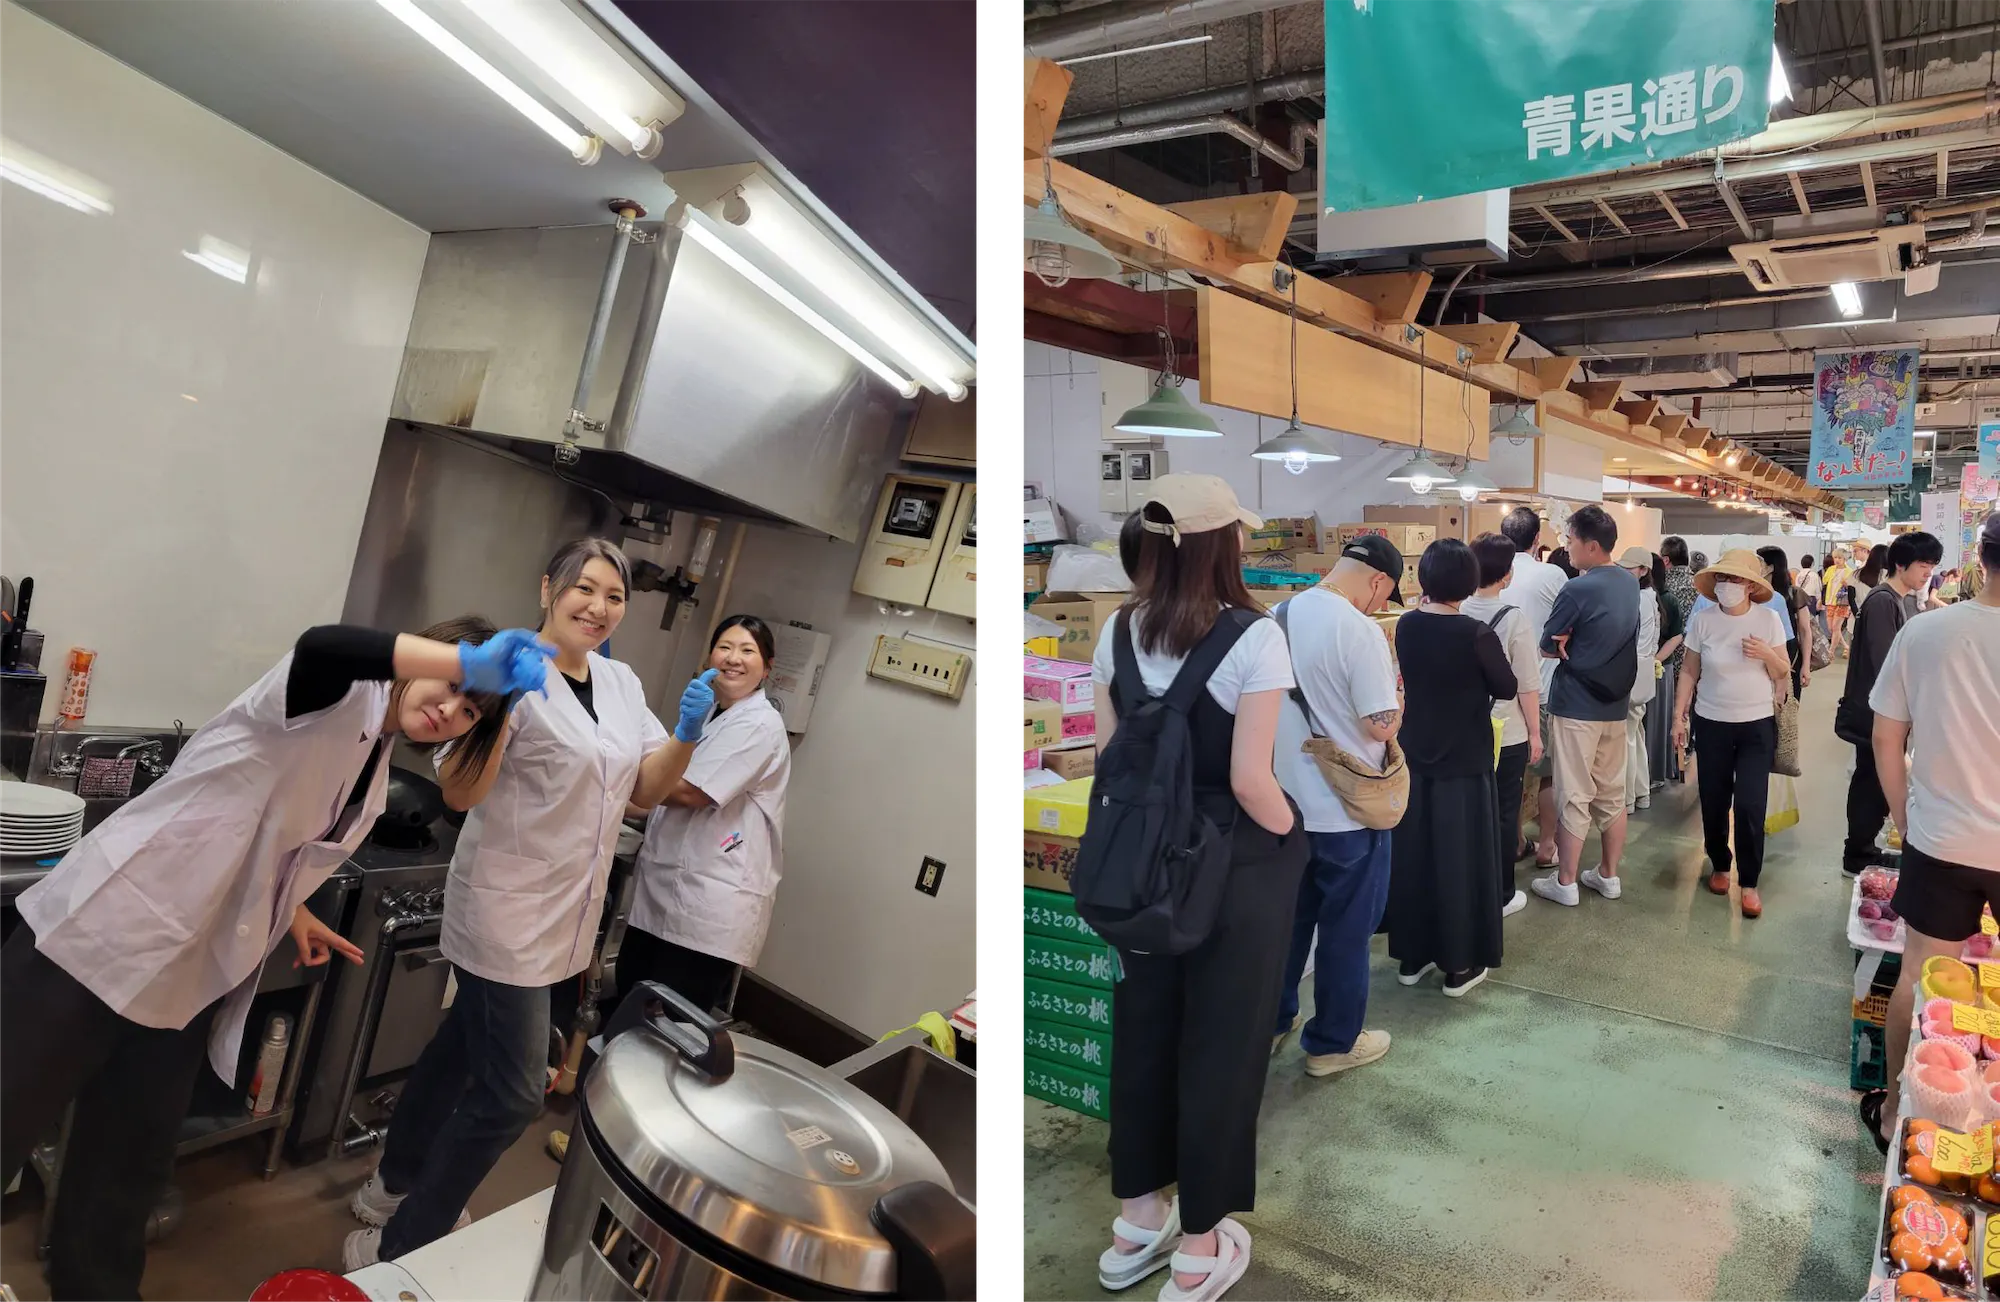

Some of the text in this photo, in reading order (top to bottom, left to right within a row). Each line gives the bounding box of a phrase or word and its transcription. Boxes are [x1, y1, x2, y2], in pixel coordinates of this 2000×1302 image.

[1522, 63, 1745, 161] 青果通り
[1027, 948, 1110, 981] ふるさとの桃
[1028, 991, 1109, 1025] ふるさとの桃
[1025, 1029, 1102, 1066] ふるさとの桃
[1027, 1070, 1100, 1110] ふるさとの桃
